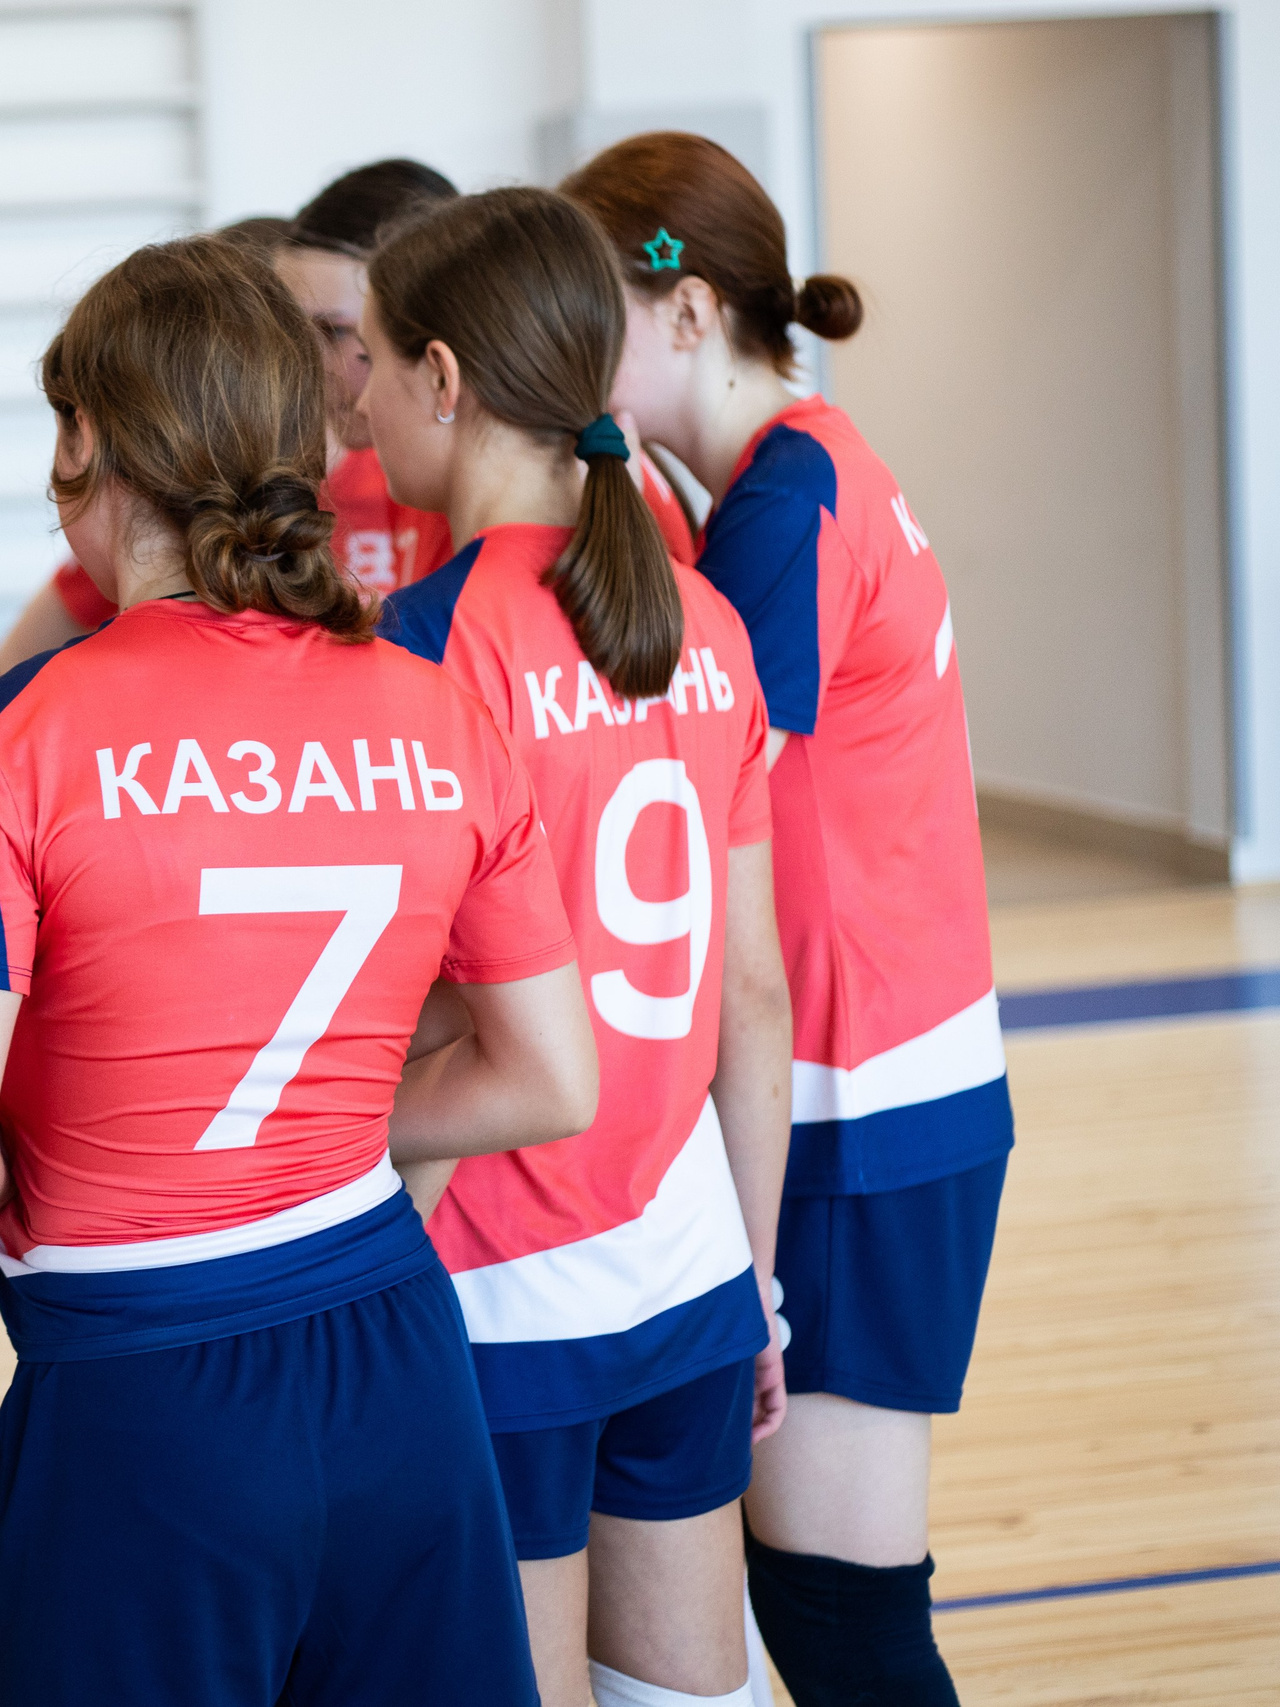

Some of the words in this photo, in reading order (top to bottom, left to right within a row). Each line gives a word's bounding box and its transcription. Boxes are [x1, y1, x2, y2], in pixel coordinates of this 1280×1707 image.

[96, 738, 464, 819] КАЗАНЬ
[591, 758, 712, 1039] 9
[193, 864, 404, 1151] 7
